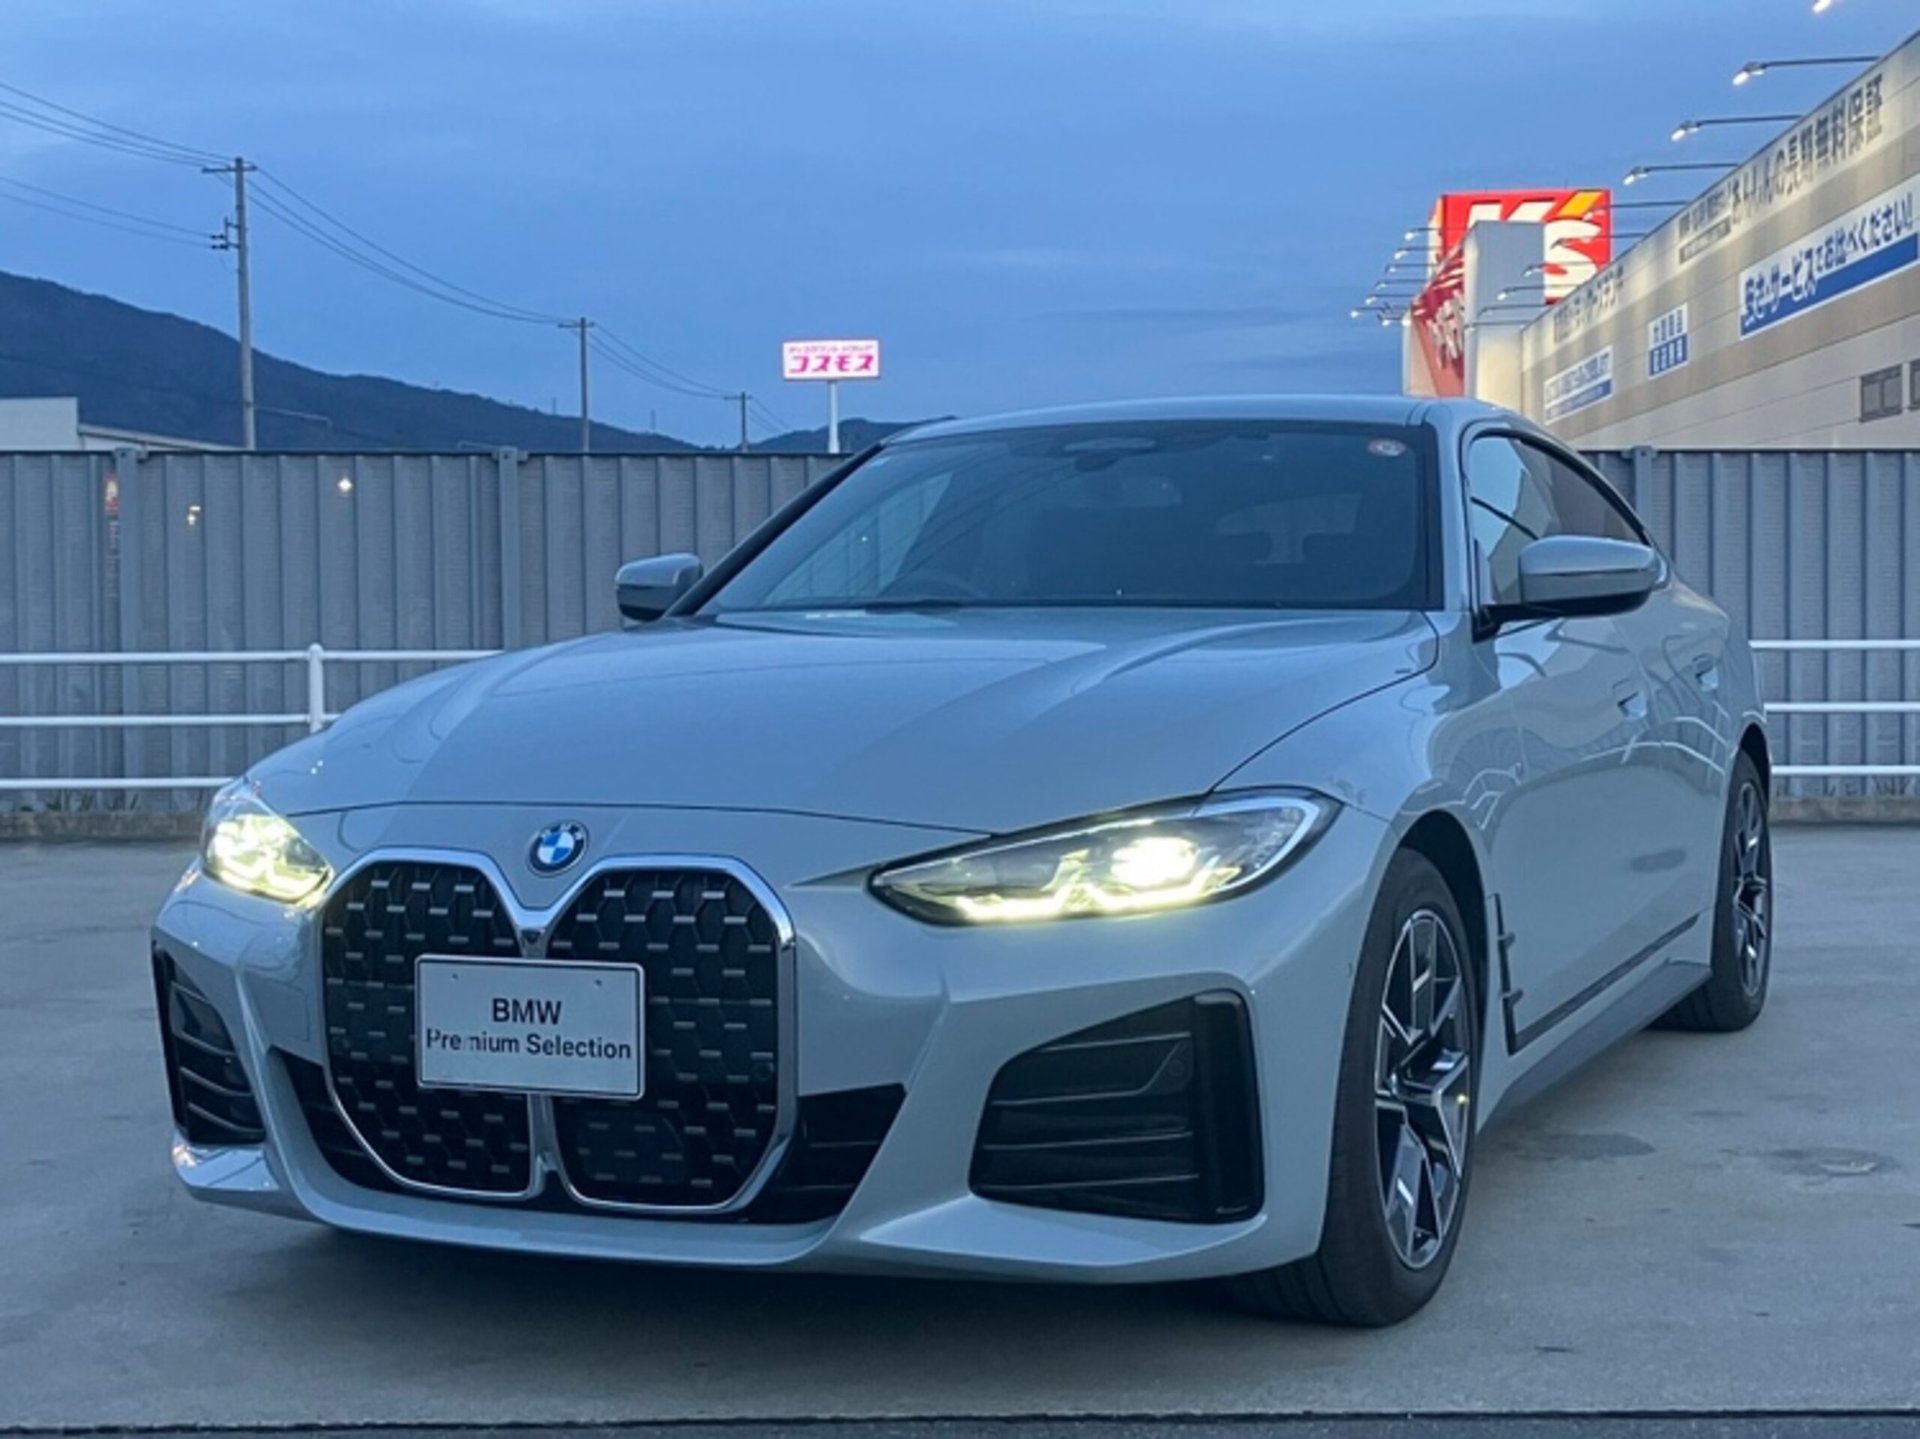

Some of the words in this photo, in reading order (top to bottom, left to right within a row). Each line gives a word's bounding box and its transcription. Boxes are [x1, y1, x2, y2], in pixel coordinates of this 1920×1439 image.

[788, 354, 874, 374] コスモス
[491, 997, 562, 1025] BMW
[526, 1032, 631, 1059] Selection
